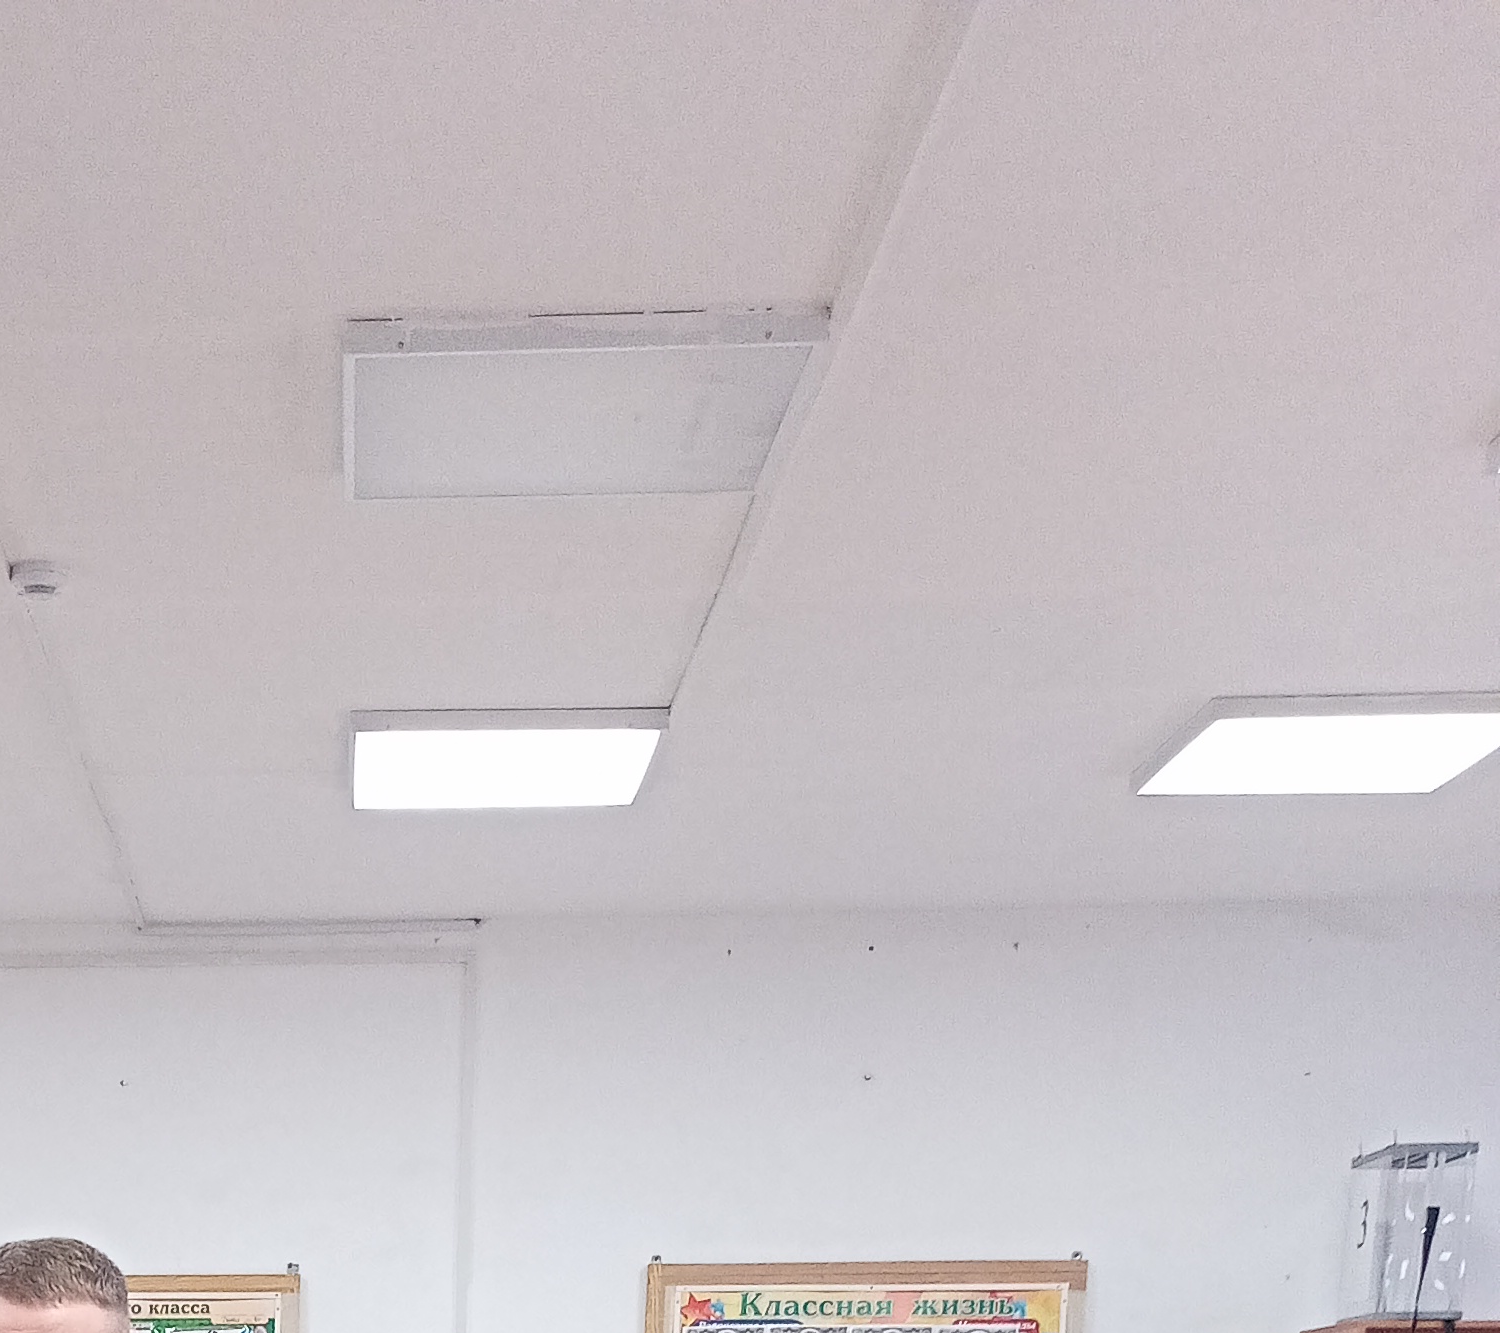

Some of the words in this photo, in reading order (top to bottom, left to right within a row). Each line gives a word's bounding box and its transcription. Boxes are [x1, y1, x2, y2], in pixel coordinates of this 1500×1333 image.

[129, 1303, 142, 1315] о
[150, 1303, 210, 1315] класса
[739, 1292, 893, 1317] Классная
[912, 1299, 1014, 1316] жизнь
